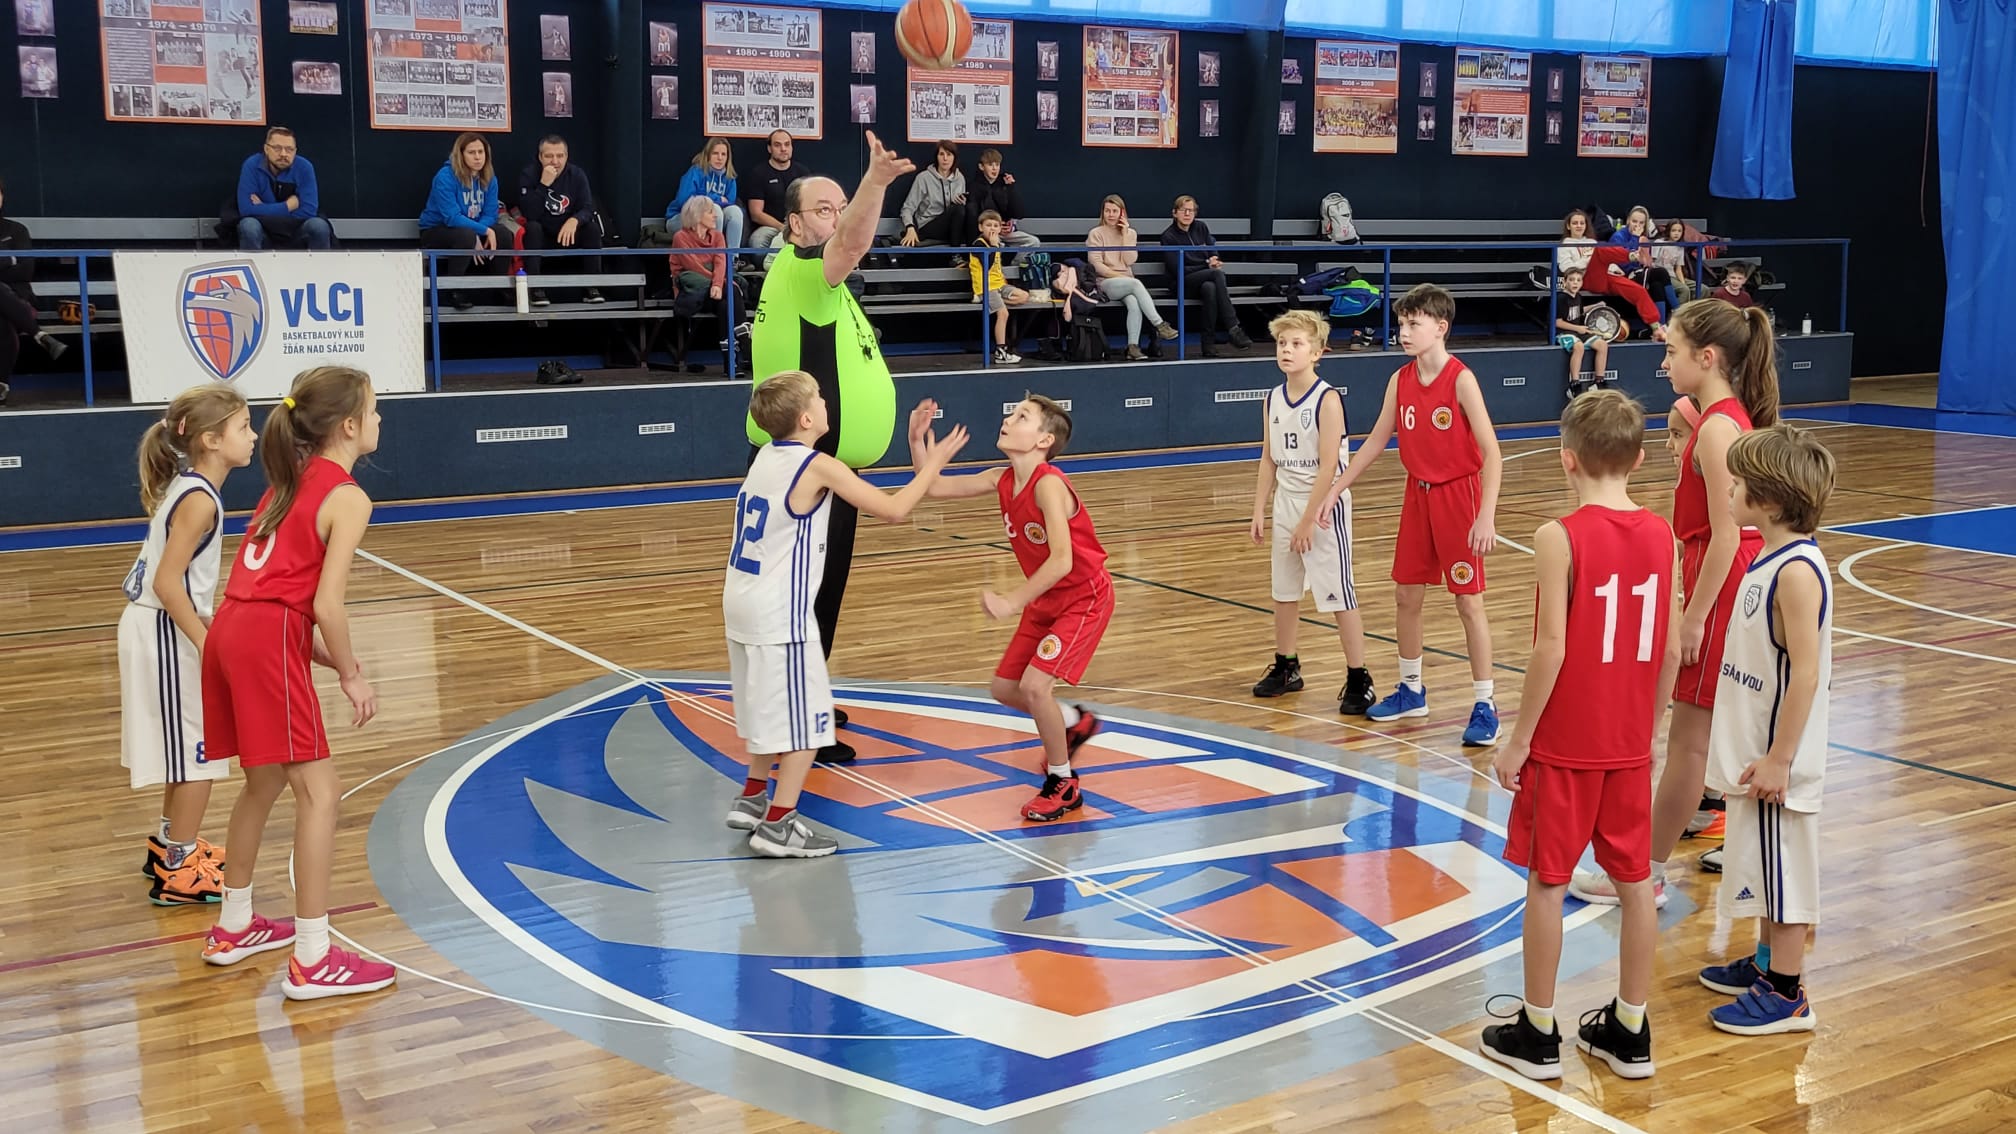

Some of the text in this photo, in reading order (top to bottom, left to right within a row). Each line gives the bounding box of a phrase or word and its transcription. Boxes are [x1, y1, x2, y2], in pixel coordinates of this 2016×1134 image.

[735, 48, 758, 57] 1980
[279, 282, 364, 327] VLCI
[282, 328, 365, 341] BASKETBALOVÝ KLUB
[283, 342, 365, 355] ŽĎÁR NAD SÁZAVOU
[1399, 404, 1416, 431] 16
[1284, 432, 1298, 449] 13
[729, 491, 770, 576] 12
[1594, 573, 1659, 664] 11
[1722, 662, 1764, 692] SÁAVOU
[814, 712, 829, 735] 12
